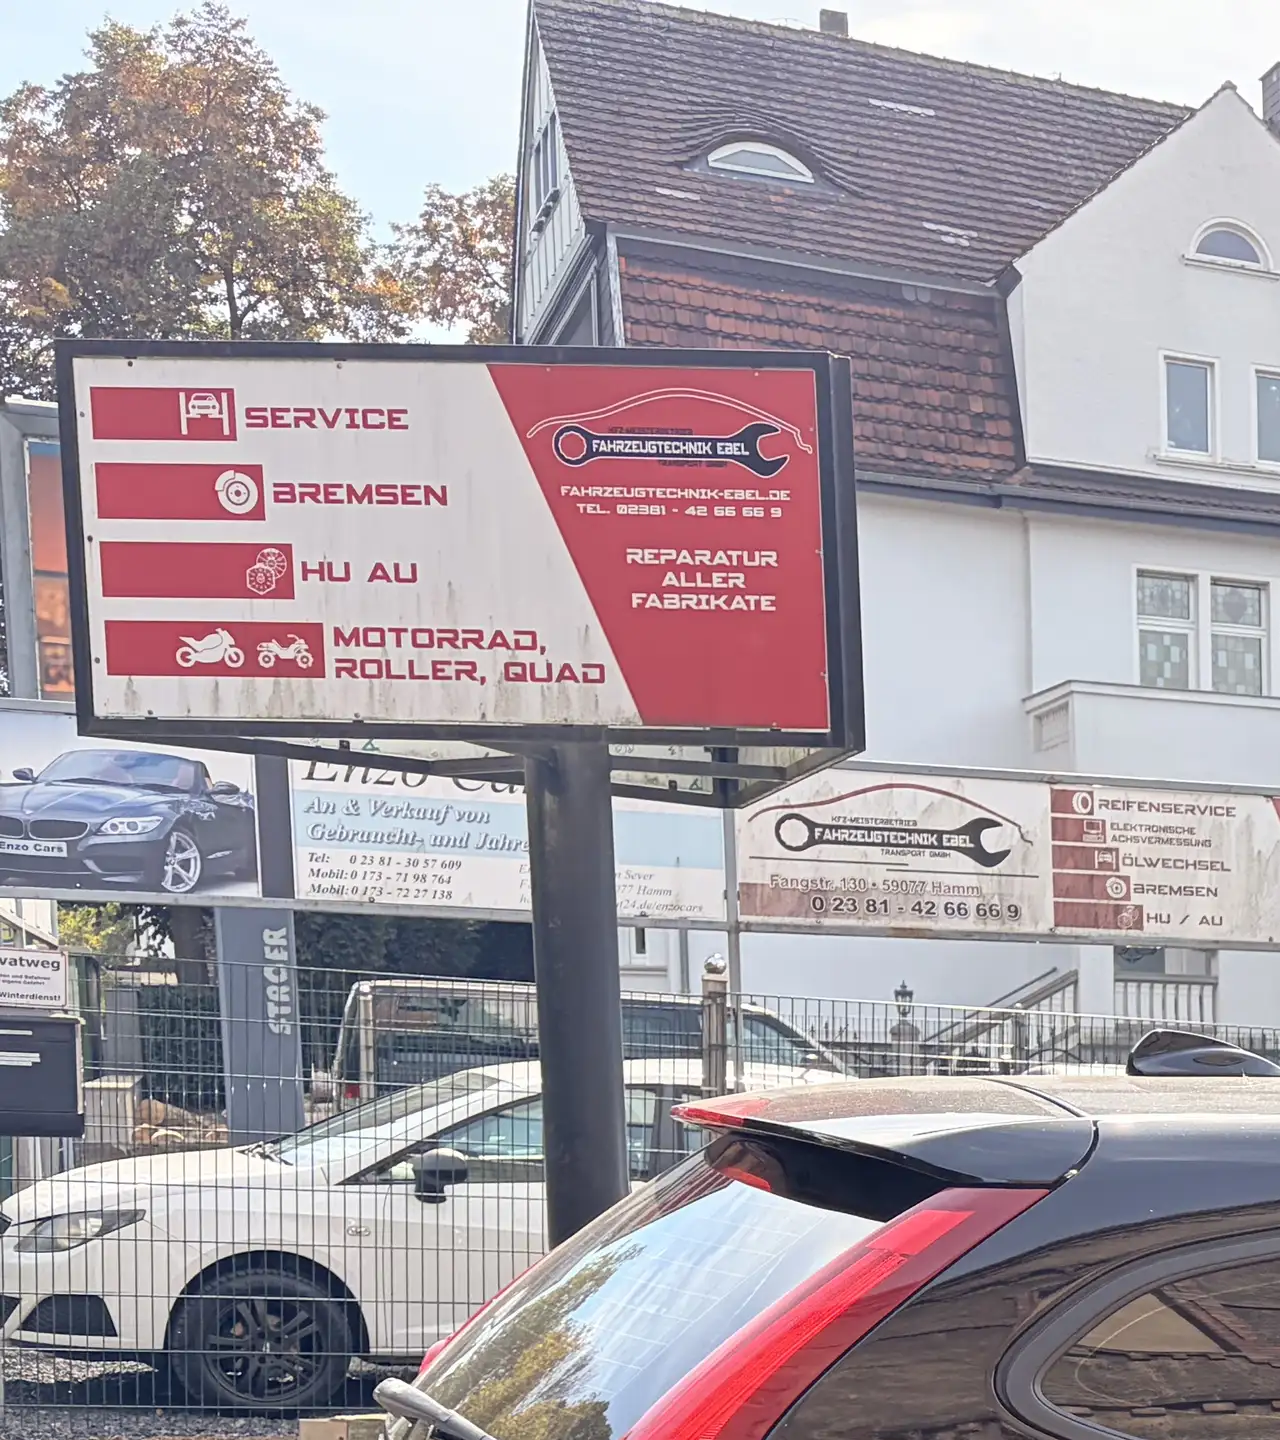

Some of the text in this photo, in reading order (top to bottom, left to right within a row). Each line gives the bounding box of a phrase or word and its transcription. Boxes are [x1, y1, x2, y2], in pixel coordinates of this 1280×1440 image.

[244, 406, 410, 430] SERVICE
[591, 439, 750, 457] FAHRZEUGTECHNIK EBEL
[272, 482, 448, 506] BREMSEN
[560, 485, 791, 501] FAHRZEUGTECHNIK-EBEL.DE
[576, 503, 611, 515] TEL.
[616, 504, 667, 516] 02381
[685, 505, 708, 517] 42
[713, 505, 736, 517] 66
[741, 506, 765, 518] 66
[770, 506, 782, 518] 9
[626, 548, 779, 568] REPARATUR
[301, 560, 418, 584] HU AU
[661, 571, 746, 589] ALLER
[631, 592, 776, 611] FABRIKATE
[333, 626, 547, 655] MOTORRAD,
[334, 657, 606, 686] ROLLER, QUAD
[303, 796, 491, 826] An & Verkauf von
[1098, 799, 1237, 818] REIFENSERVICE
[306, 823, 424, 846] Gebraucht-
[429, 832, 469, 849] und
[813, 826, 975, 848] FAHRZEUGTECHNIK EBEL
[1110, 822, 1197, 836] ELEKTRONISCHE
[0, 841, 64, 853] Enzo Cars
[1110, 834, 1212, 848] ACHSVERMESSUNG
[308, 852, 331, 864] Tel:
[349, 854, 357, 865] 0
[359, 855, 375, 865] 23
[378, 855, 393, 866] 81
[405, 857, 420, 868] 30
[422, 858, 437, 869] 57
[440, 858, 462, 871] 609
[880, 848, 927, 858] TRANSPORT
[1122, 852, 1232, 873] ÖLWECHSEL
[308, 867, 348, 880] Mobil:
[350, 869, 358, 880] 0
[360, 870, 383, 881] 173
[395, 872, 409, 883] 71
[412, 873, 427, 884] 98
[430, 873, 452, 885] 764
[769, 874, 982, 897] Fangstr. 130 59077 Hamm
[309, 883, 349, 896] Mobil:
[350, 885, 358, 896] 0
[361, 885, 383, 897] 173
[395, 887, 410, 898] 72
[413, 888, 428, 899] 27
[431, 889, 453, 900] 138
[636, 885, 673, 897] Hamm
[1133, 883, 1218, 898] BREMSEN
[811, 896, 825, 913] 0
[832, 897, 859, 914] 23
[865, 898, 890, 915] 81
[910, 900, 937, 916] 42
[944, 901, 969, 918] 66
[975, 902, 1000, 919] 66
[1008, 903, 1021, 920] 9
[1146, 912, 1171, 924] HU
[1199, 914, 1223, 927] AU
